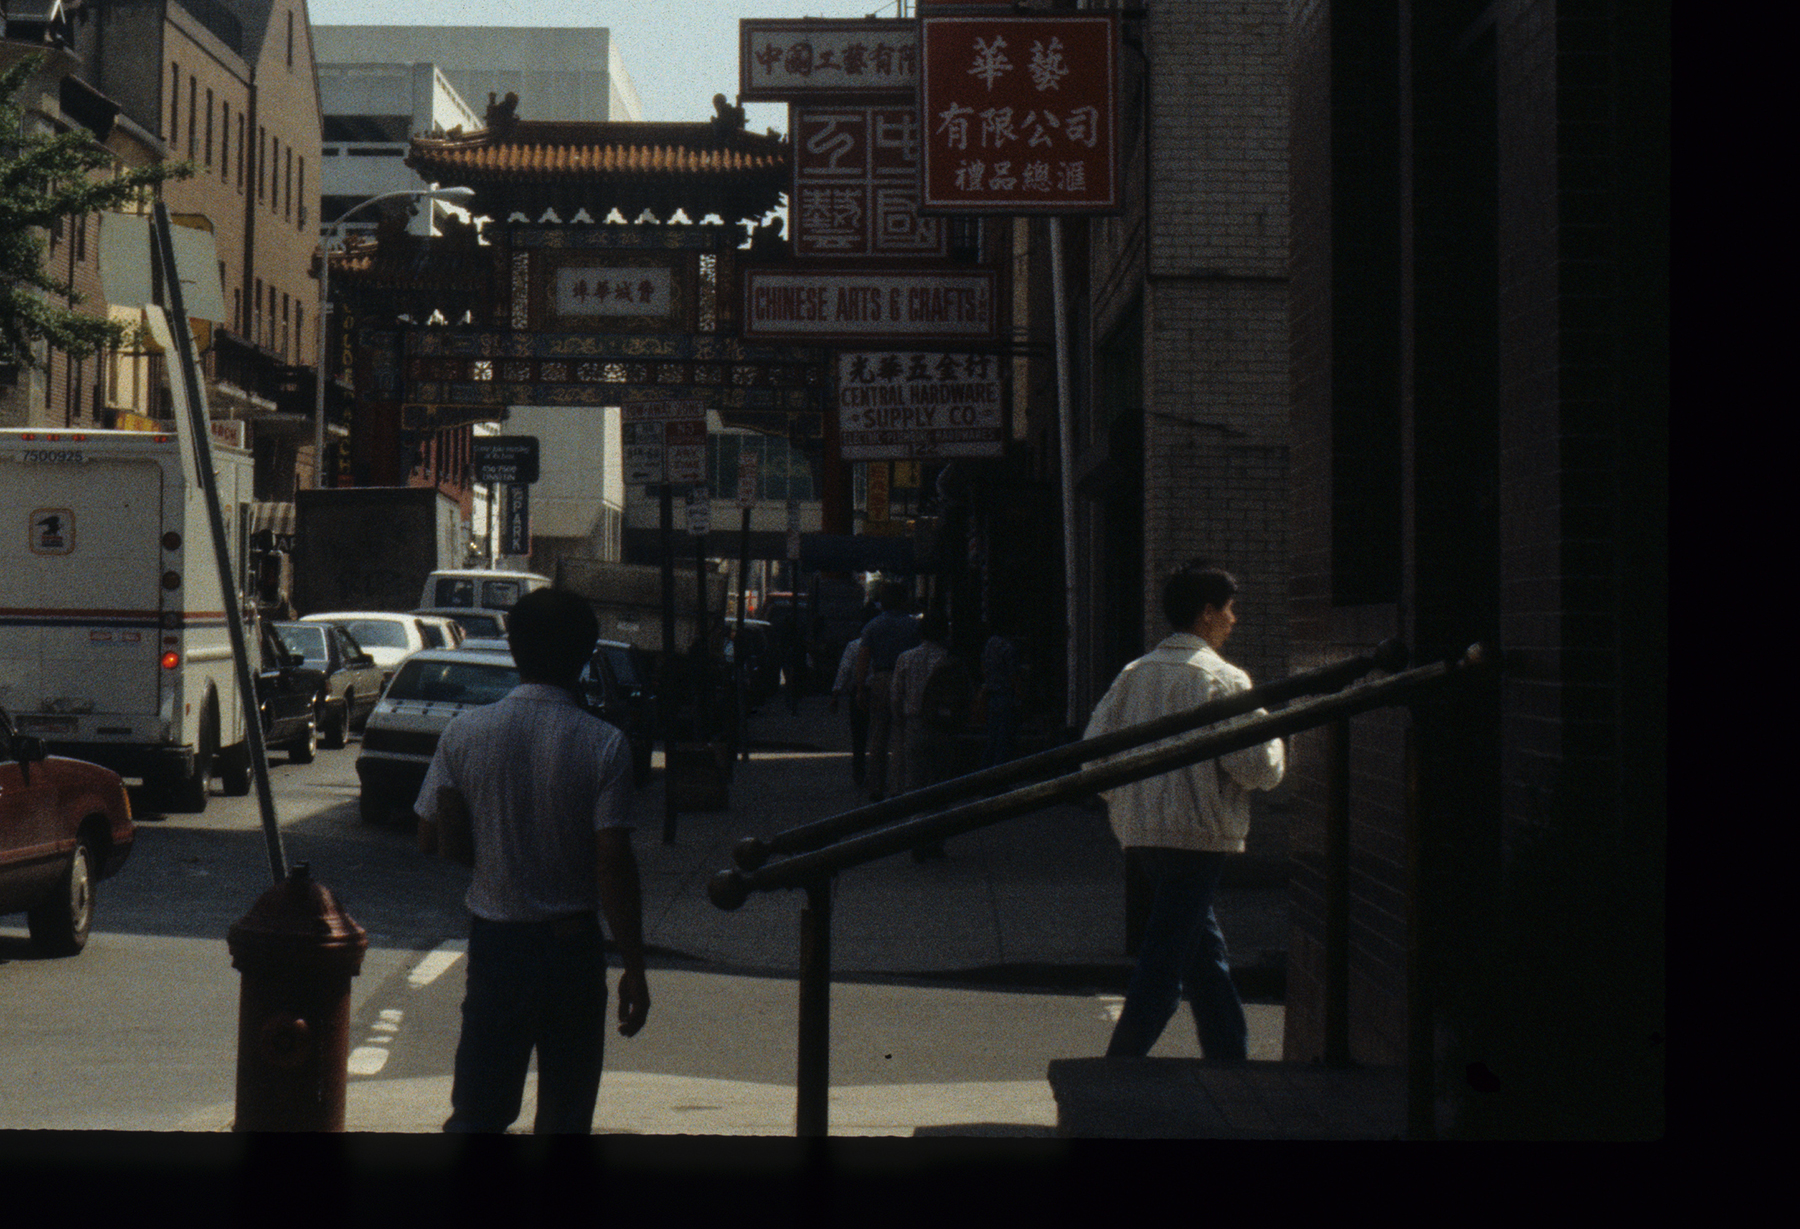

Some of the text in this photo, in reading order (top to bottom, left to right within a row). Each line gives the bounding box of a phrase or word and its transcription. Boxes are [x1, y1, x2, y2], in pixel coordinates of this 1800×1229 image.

[968, 35, 1069, 93] 華藝
[935, 101, 1099, 151] 有限公司
[755, 286, 828, 321] CHINESE
[836, 286, 882, 321] ARTS
[908, 286, 976, 322] CRAFTS
[850, 354, 991, 384] 光華五金行
[841, 382, 996, 407] CENTRAL HARDWARE
[863, 405, 937, 429] SUPPLY
